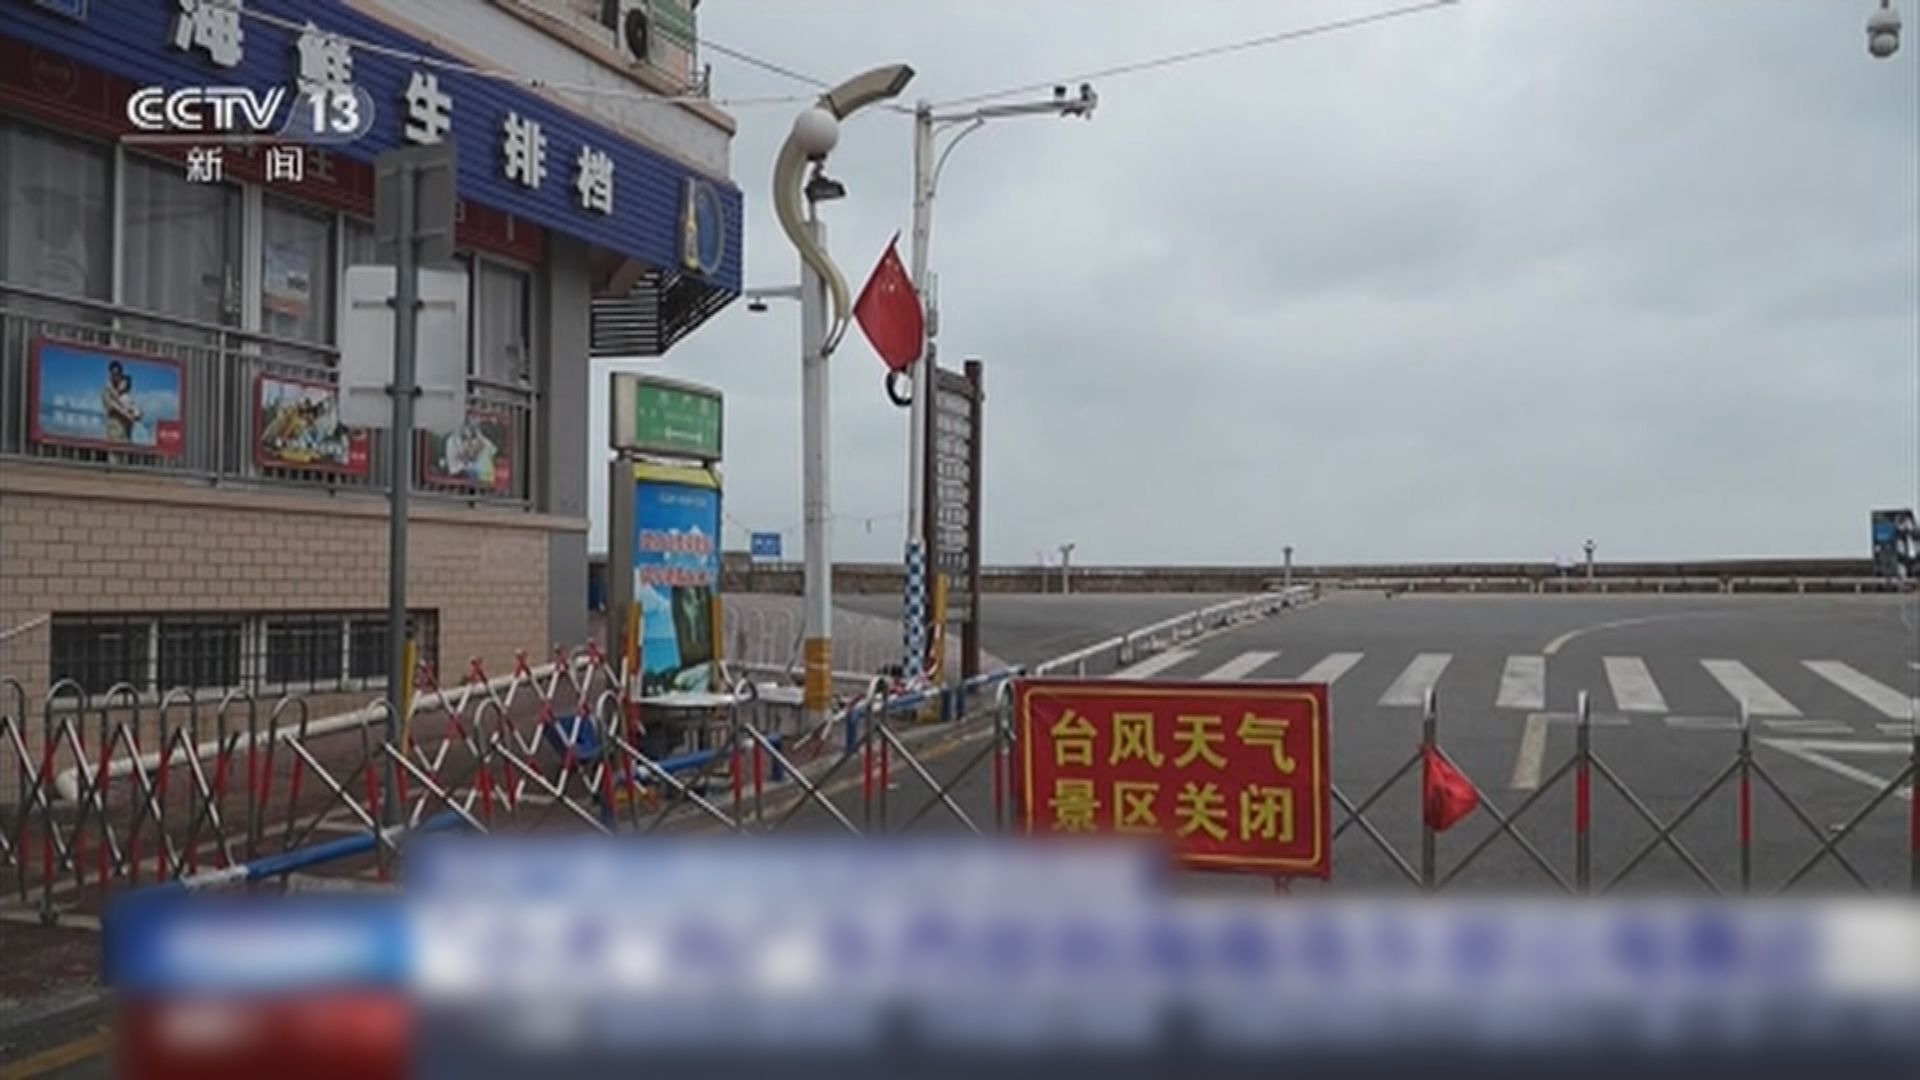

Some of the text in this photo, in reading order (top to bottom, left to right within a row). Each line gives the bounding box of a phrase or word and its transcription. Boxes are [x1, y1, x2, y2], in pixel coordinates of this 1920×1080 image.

[1051, 710, 1296, 774] 台风天气
[1048, 779, 1295, 842] 景区关闭
